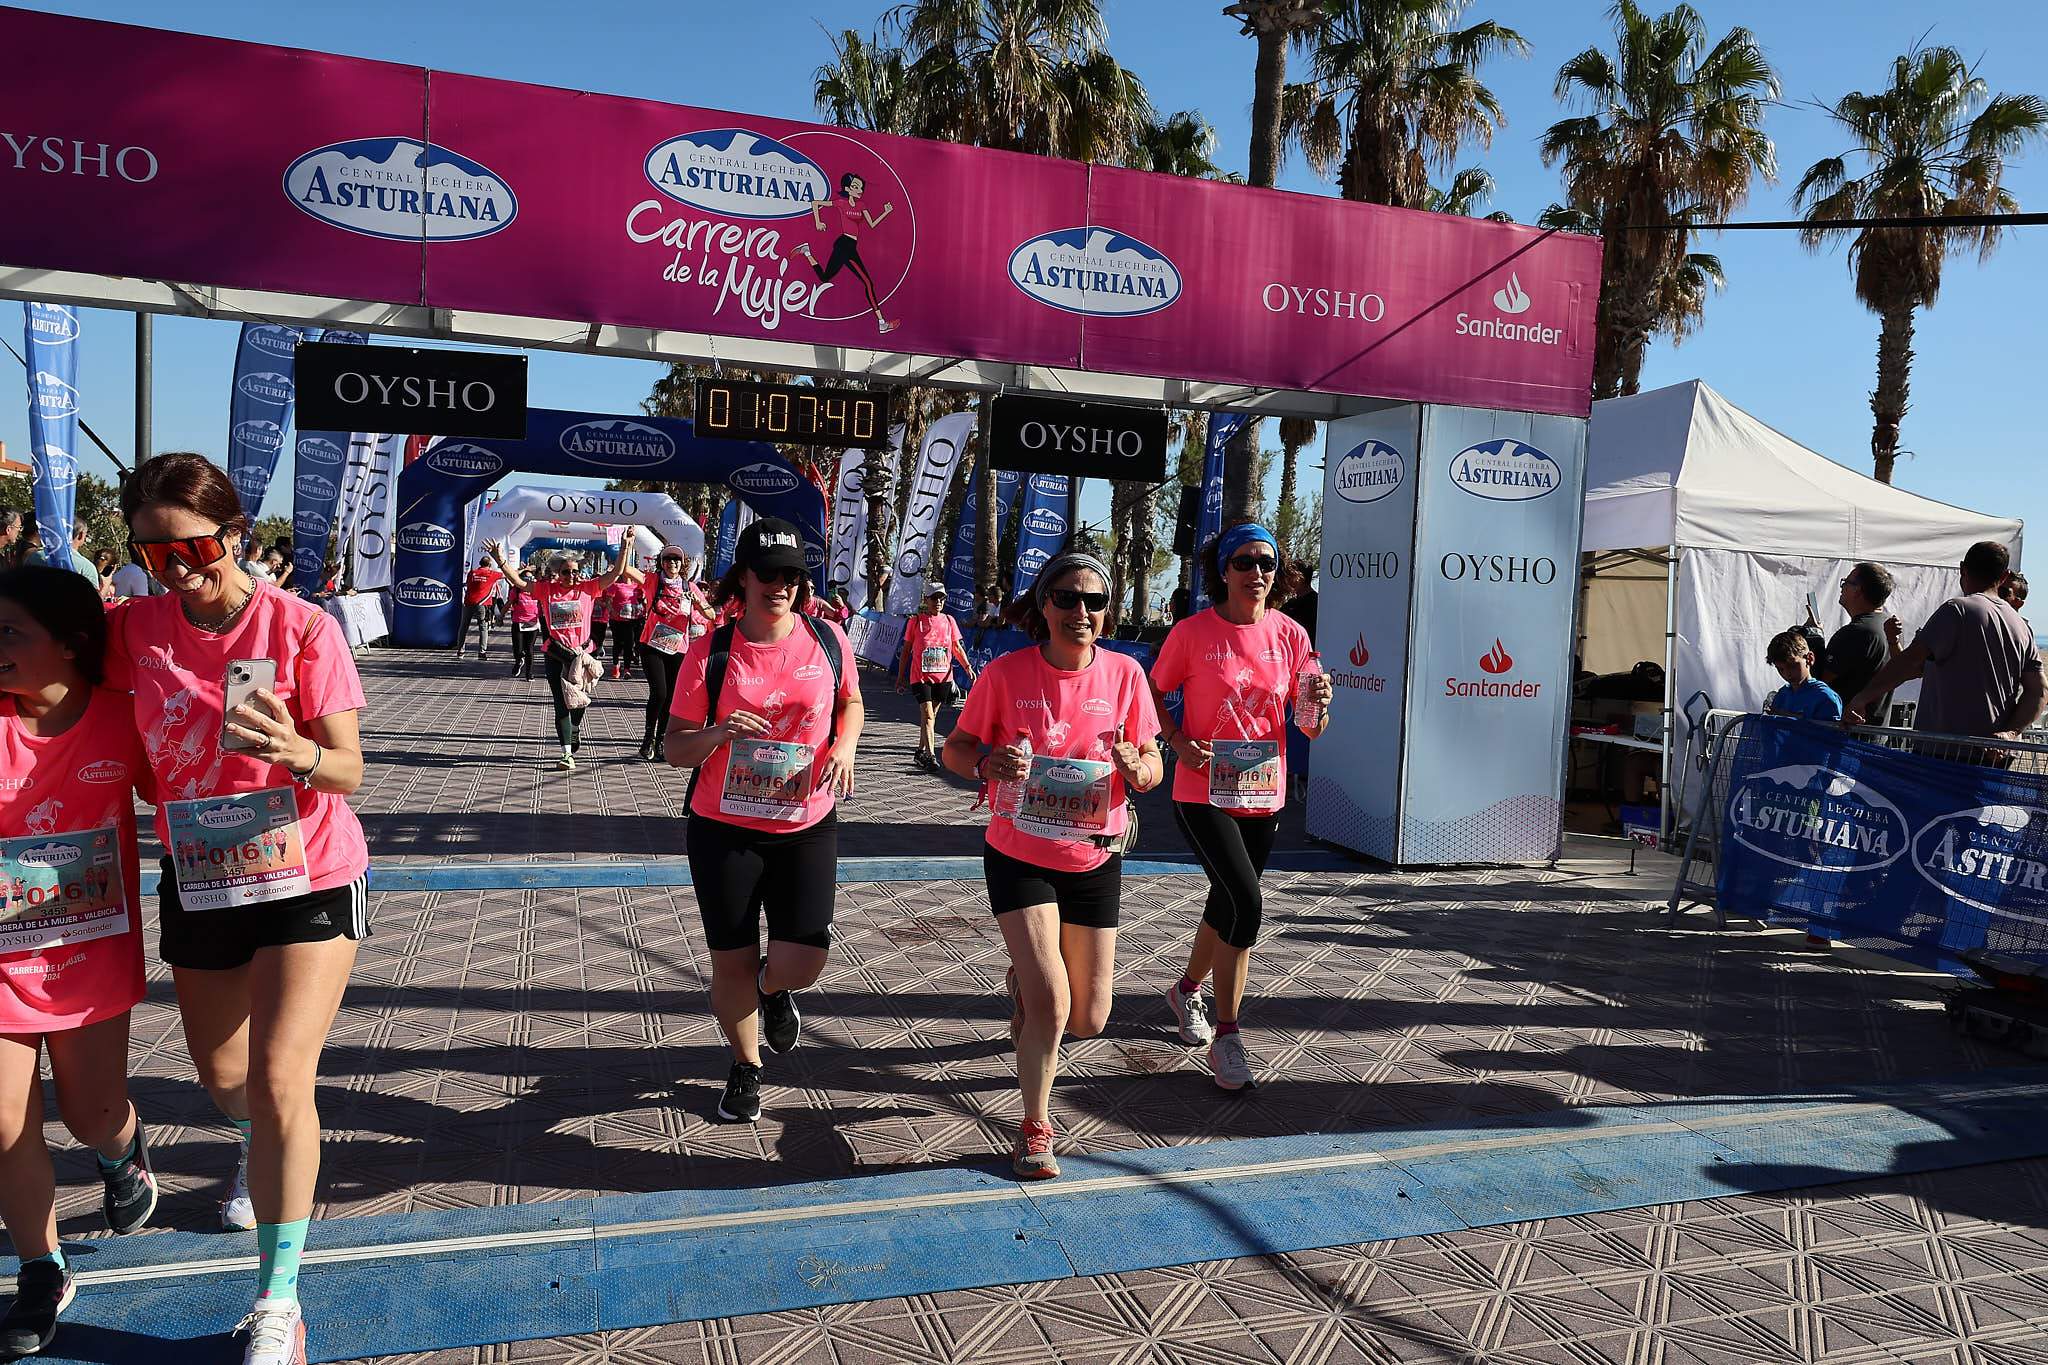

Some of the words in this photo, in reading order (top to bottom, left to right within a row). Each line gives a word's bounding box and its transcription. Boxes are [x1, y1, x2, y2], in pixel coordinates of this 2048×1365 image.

[340, 166, 413, 184] CENTRAL
[689, 153, 748, 169] CENTRAL
[754, 162, 812, 178] LECHERA
[659, 152, 816, 203] ASTURIANA
[302, 165, 500, 222] ASTURIANA
[626, 199, 781, 260] Carrera
[1050, 252, 1104, 267] CENTRAL
[1110, 259, 1165, 274] LECHERA
[1022, 251, 1169, 299] ASTURIANA
[662, 251, 692, 283] de
[698, 253, 719, 287] la
[712, 255, 835, 331] Mujer
[1262, 282, 1386, 323] OYSHO
[1455, 311, 1563, 345] Santander
[334, 372, 496, 412] OYSHO
[709, 388, 874, 438] 01:07:40
[568, 431, 668, 458] ASTURIANA
[1020, 421, 1143, 458] OYSHO
[431, 452, 497, 471] ASTURIANA
[735, 473, 795, 487] ASTURIANA
[1337, 466, 1399, 490] ASTURIANA
[1456, 458, 1553, 488] ASTURIANA
[490, 511, 520, 519] OYSHO
[547, 494, 639, 516] OYSHO
[898, 437, 956, 578] OYSHO
[833, 467, 866, 586] OYSHO
[400, 531, 451, 547] ASTURIANA
[1330, 551, 1399, 579] OYSHO
[1440, 552, 1556, 585] OYSHO
[397, 587, 449, 601] ASTURIANA
[727, 676, 764, 687] OYSHO
[1330, 668, 1386, 693] Santander
[1445, 677, 1541, 698] Santander
[1016, 699, 1052, 709] OYSHO
[752, 774, 784, 789] 016
[1046, 794, 1081, 810] 016
[1828, 801, 1889, 824] LECHERA
[203, 812, 253, 825] ASTURIANA
[1021, 823, 1050, 834] OYSHO
[1077, 822, 1101, 830] VALENCIA
[1738, 788, 1890, 858] ASTURIANA
[23, 851, 79, 864] ASTURIANA
[209, 842, 260, 865] 016
[183, 881, 211, 891] CARRERA
[212, 880, 221, 889] DE
[222, 878, 232, 887] LA
[233, 875, 258, 886] MUJER
[264, 868, 299, 881] VALENCIA
[223, 866, 247, 877] 3457
[27, 882, 83, 906] 016
[190, 892, 228, 905] OYSHO
[254, 884, 295, 897] Santander
[25, 921, 37, 929] DE
[38, 919, 49, 928] LA
[51, 914, 79, 926] MUJER
[85, 907, 118, 921] VALENCIA
[40, 907, 67, 918] 3459
[72, 922, 112, 938] Santander
[9, 965, 45, 975] CARRERA
[46, 964, 57, 973] DE
[42, 972, 61, 982] 2024
